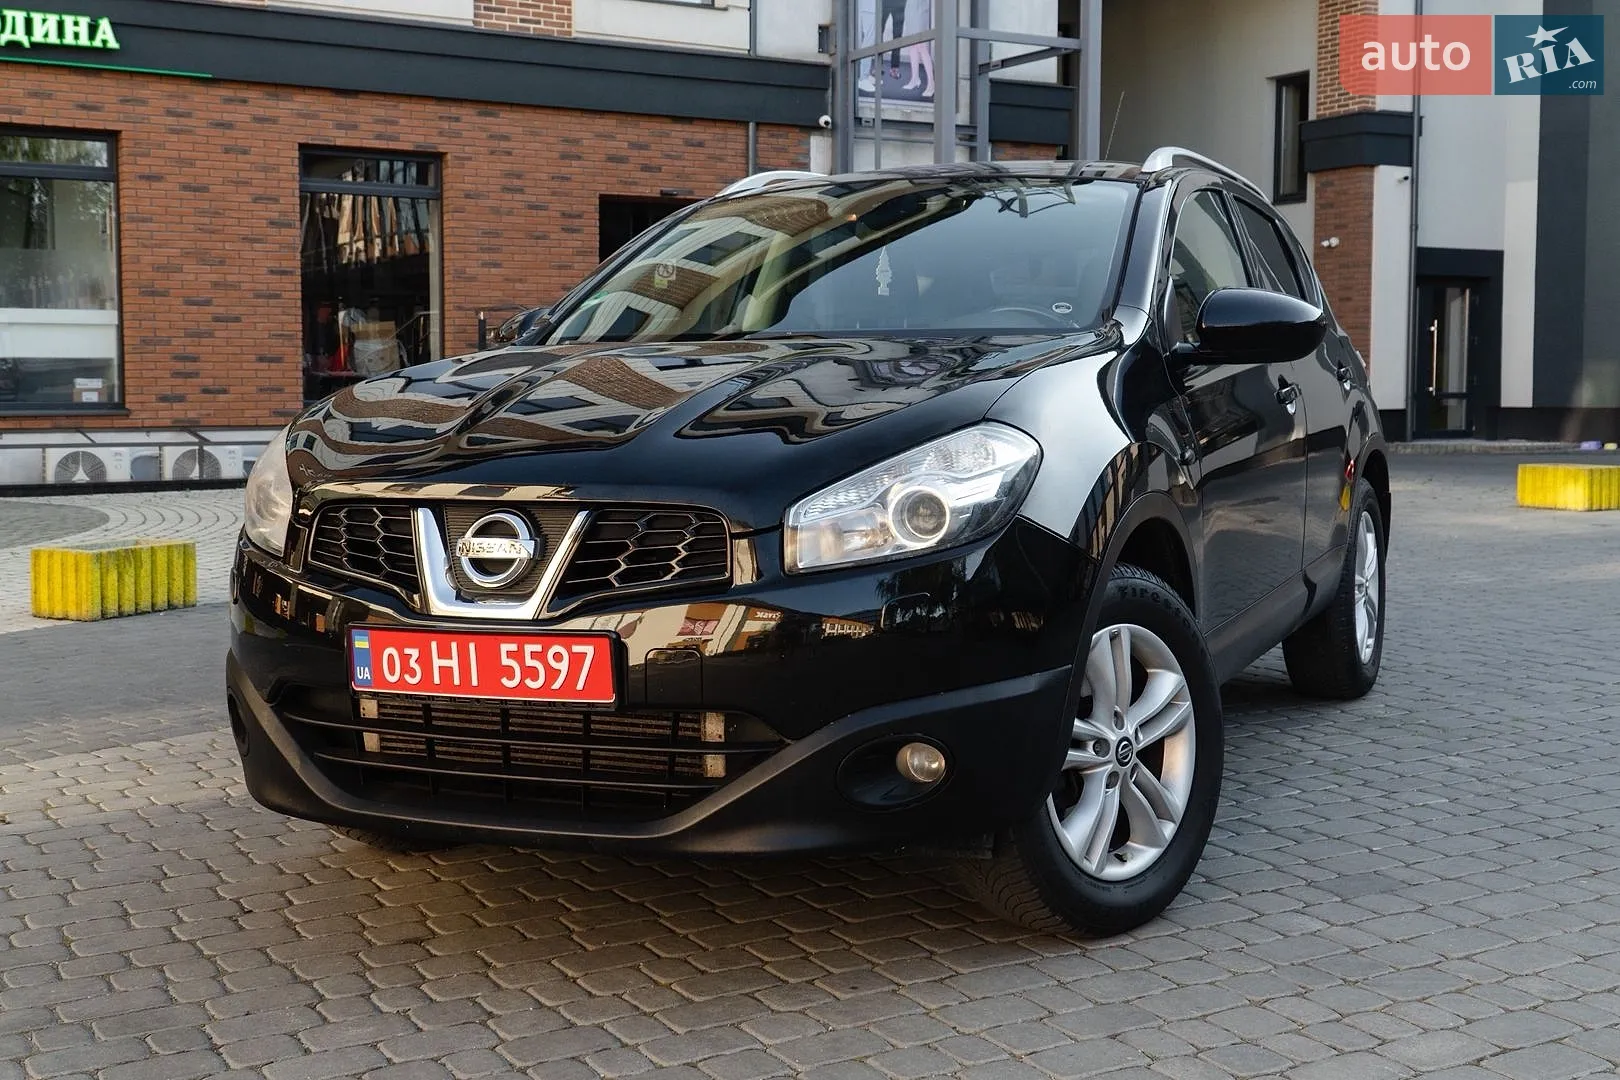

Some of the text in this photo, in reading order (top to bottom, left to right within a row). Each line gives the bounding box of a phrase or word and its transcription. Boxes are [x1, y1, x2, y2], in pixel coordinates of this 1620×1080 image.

[0, 9, 120, 49] ДИНА
[458, 540, 523, 556] NISSAN
[356, 666, 371, 681] UA
[499, 643, 596, 691] 5597
